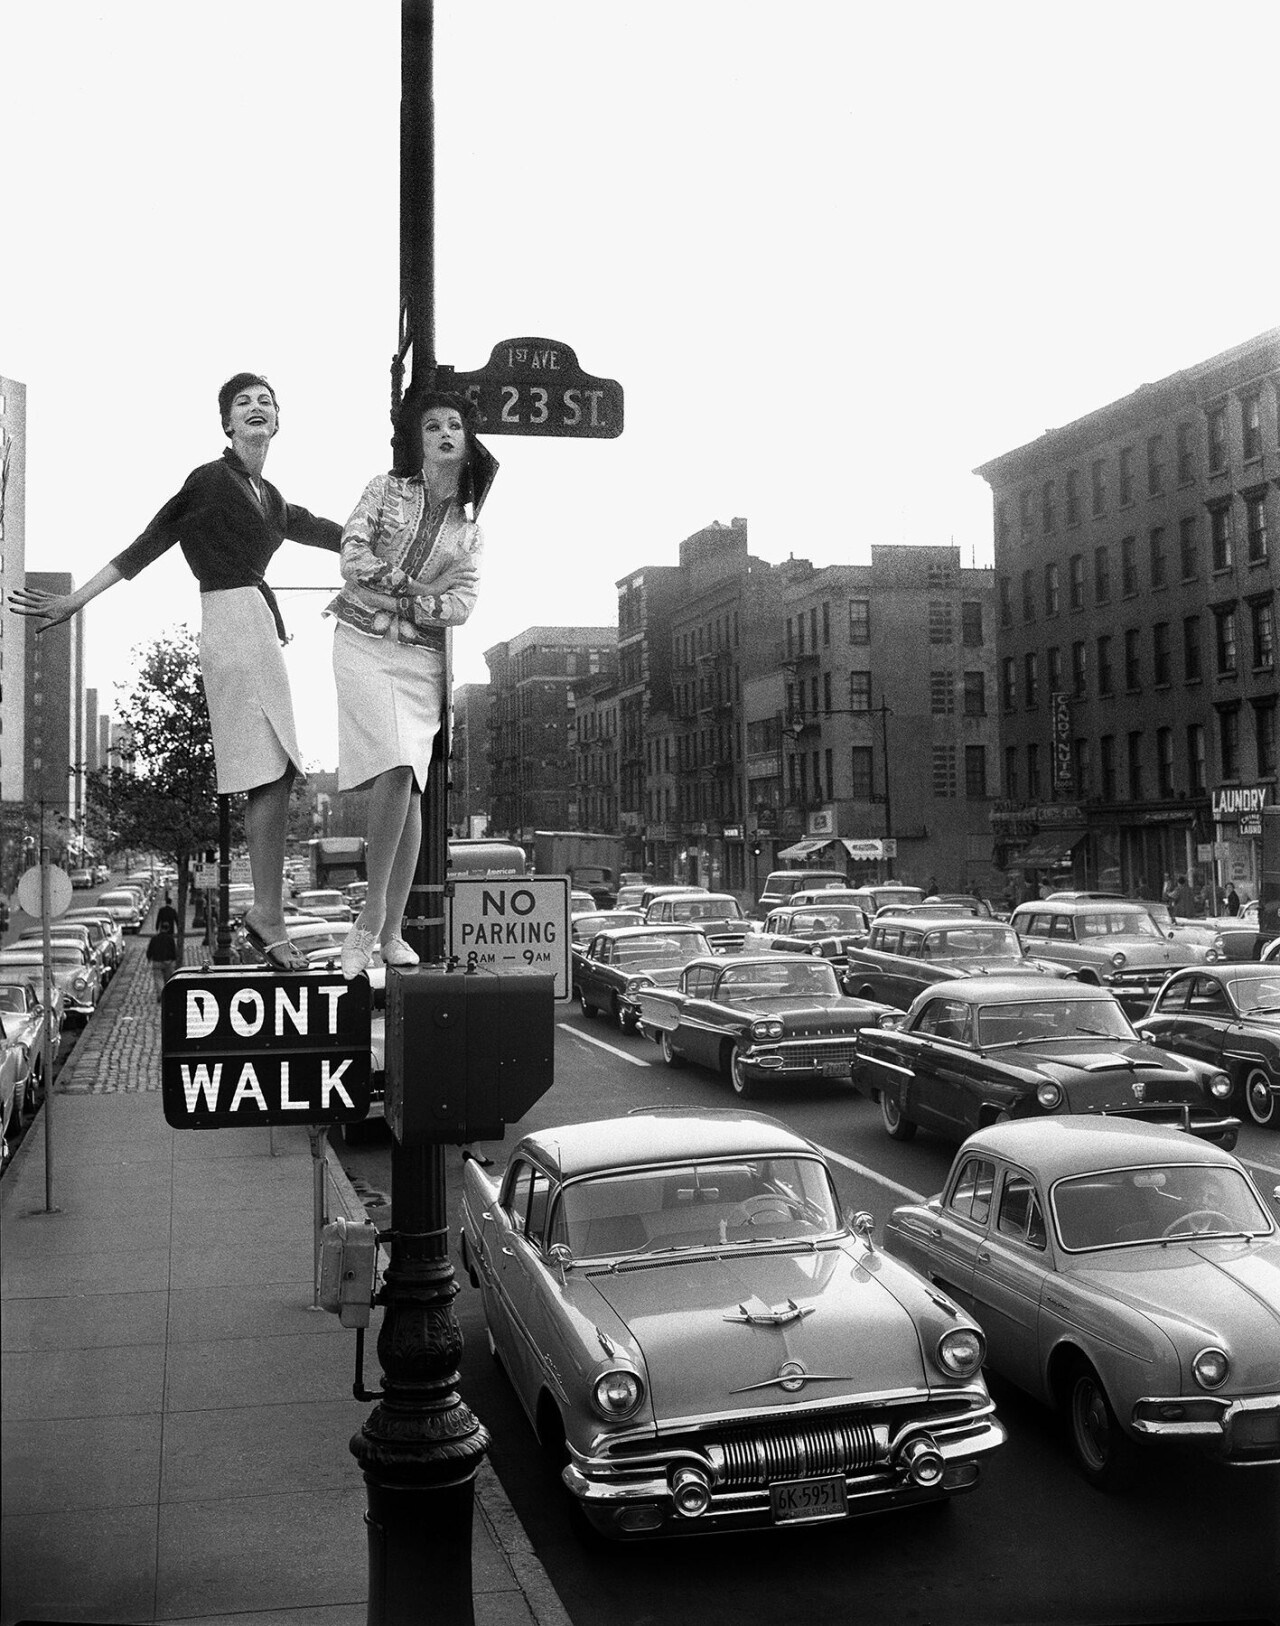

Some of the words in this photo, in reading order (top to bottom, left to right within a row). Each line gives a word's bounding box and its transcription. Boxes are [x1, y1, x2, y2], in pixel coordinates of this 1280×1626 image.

[501, 386, 549, 424] 23
[1057, 695, 1070, 739] CANDY
[1058, 743, 1071, 779] NUTS
[1212, 788, 1266, 812] LAUNDRY
[482, 889, 536, 916] NO
[462, 921, 556, 945] PARKING
[522, 950, 551, 965] 9AM
[185, 985, 349, 1039] DONT
[180, 1059, 355, 1113] WALK
